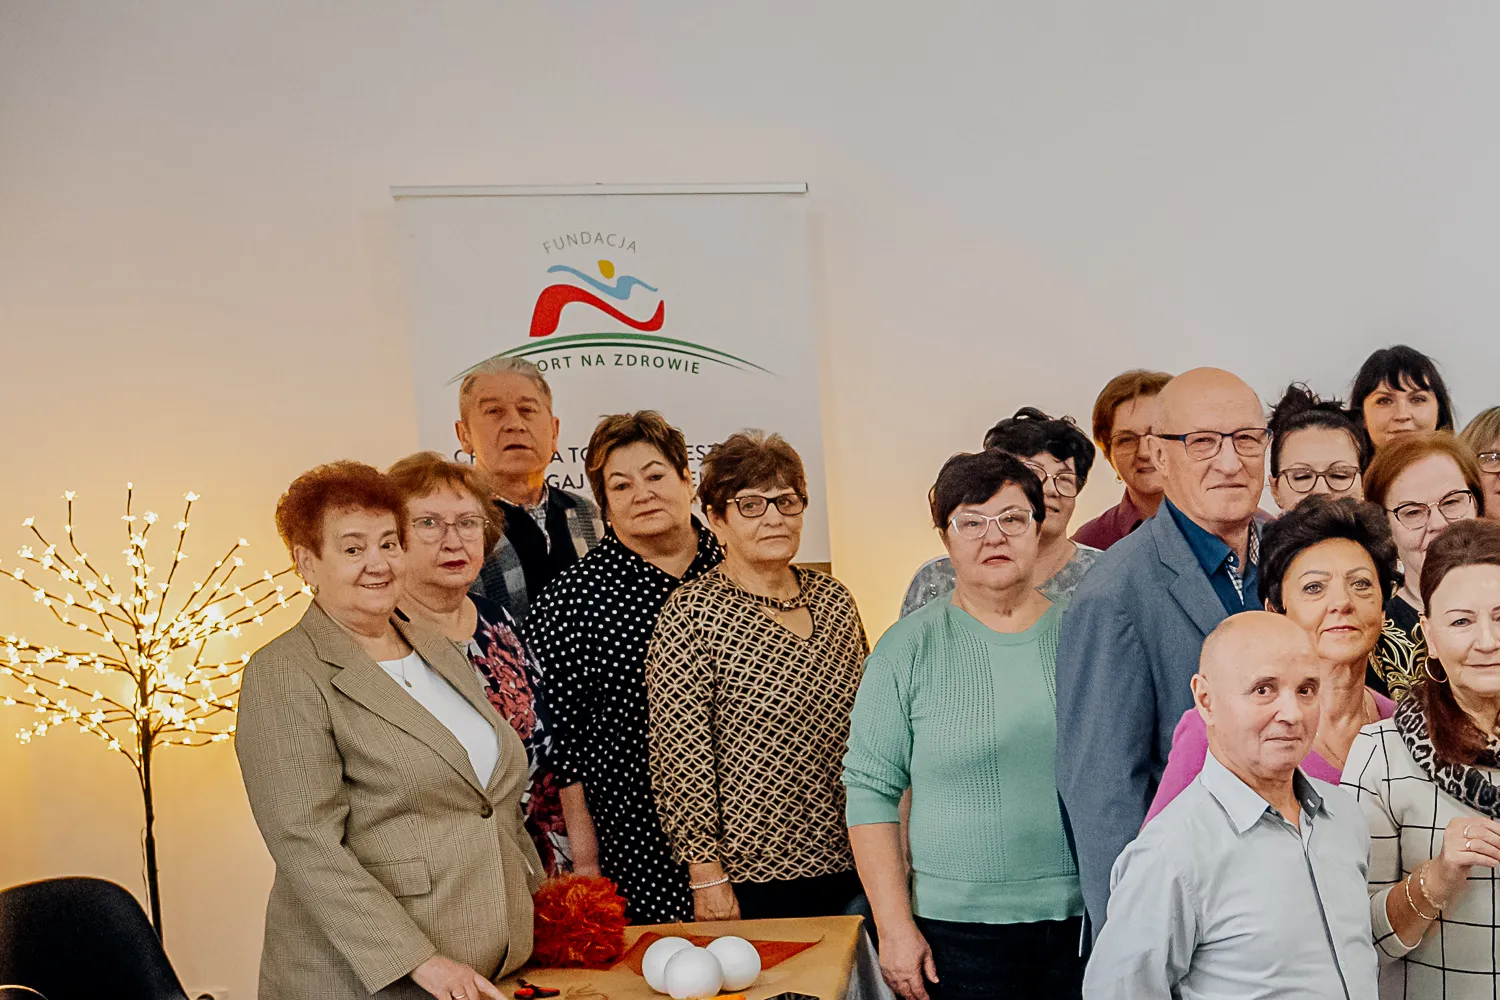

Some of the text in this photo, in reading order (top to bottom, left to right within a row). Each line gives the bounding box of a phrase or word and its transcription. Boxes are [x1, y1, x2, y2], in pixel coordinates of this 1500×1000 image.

[542, 231, 637, 254] FUNDACJA
[536, 353, 700, 374] ORT NA ZDROWIE
